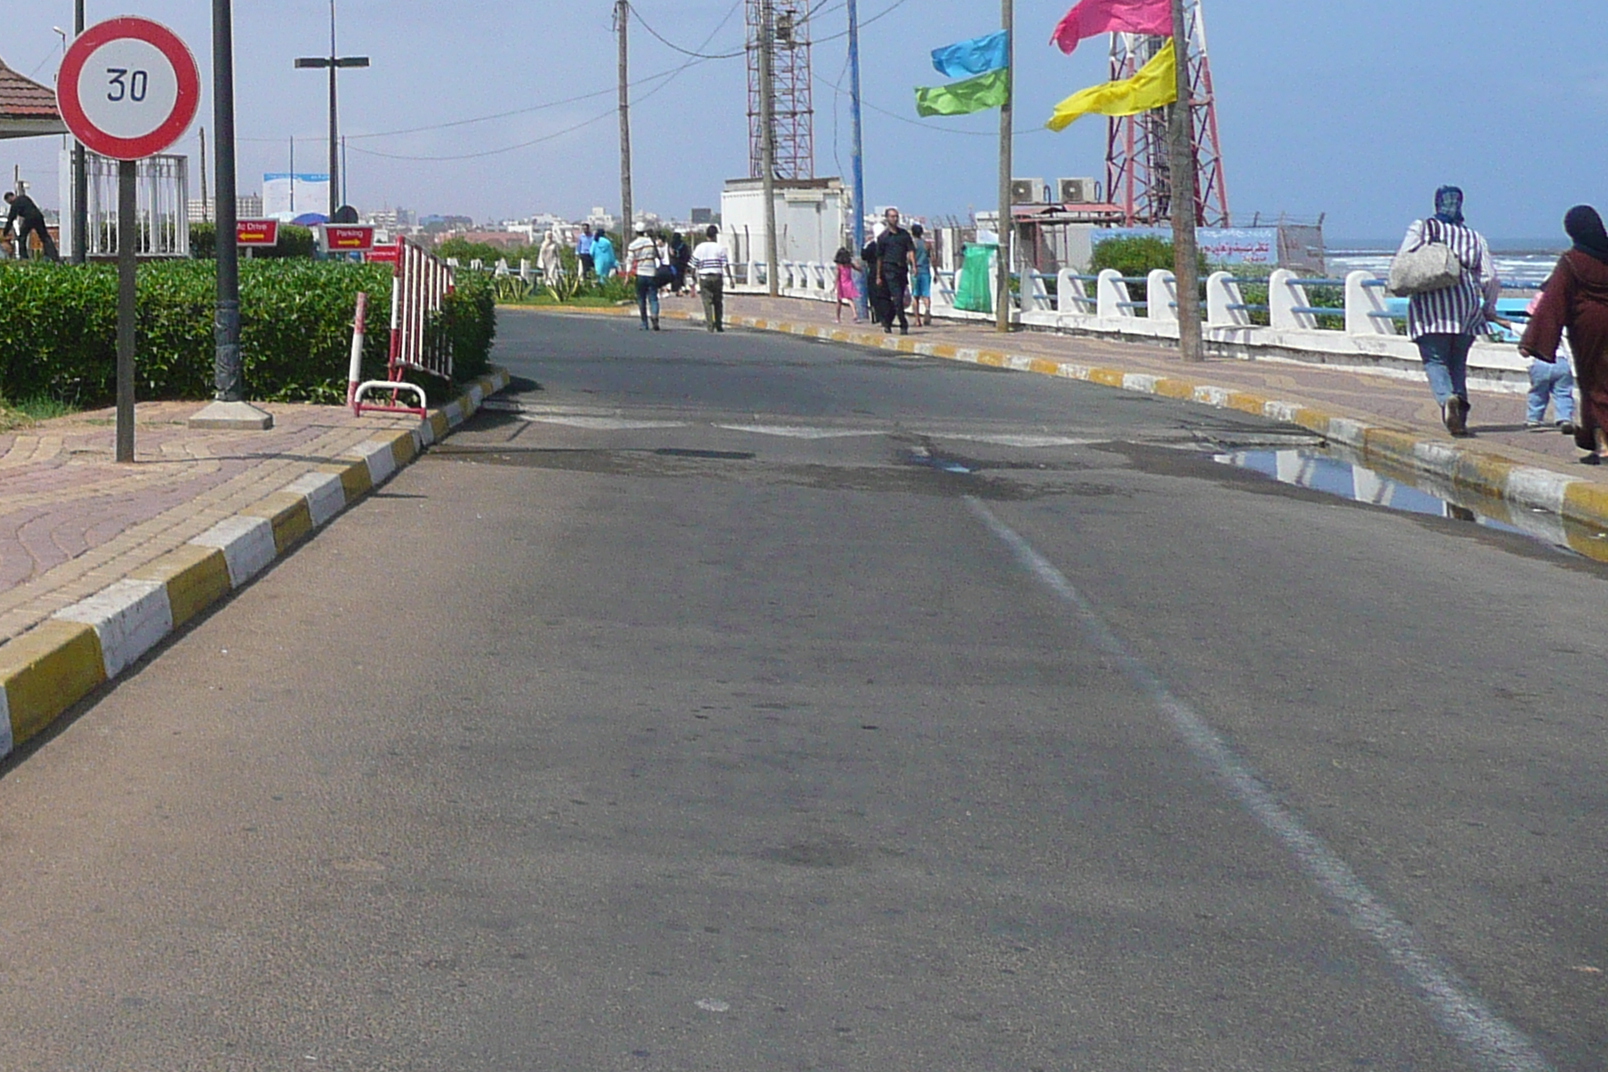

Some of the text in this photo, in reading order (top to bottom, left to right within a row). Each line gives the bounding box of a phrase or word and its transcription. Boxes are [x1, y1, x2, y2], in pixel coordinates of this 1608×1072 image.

[106, 68, 148, 102] 30
[247, 221, 267, 230] Drive
[336, 229, 364, 238] Parking
